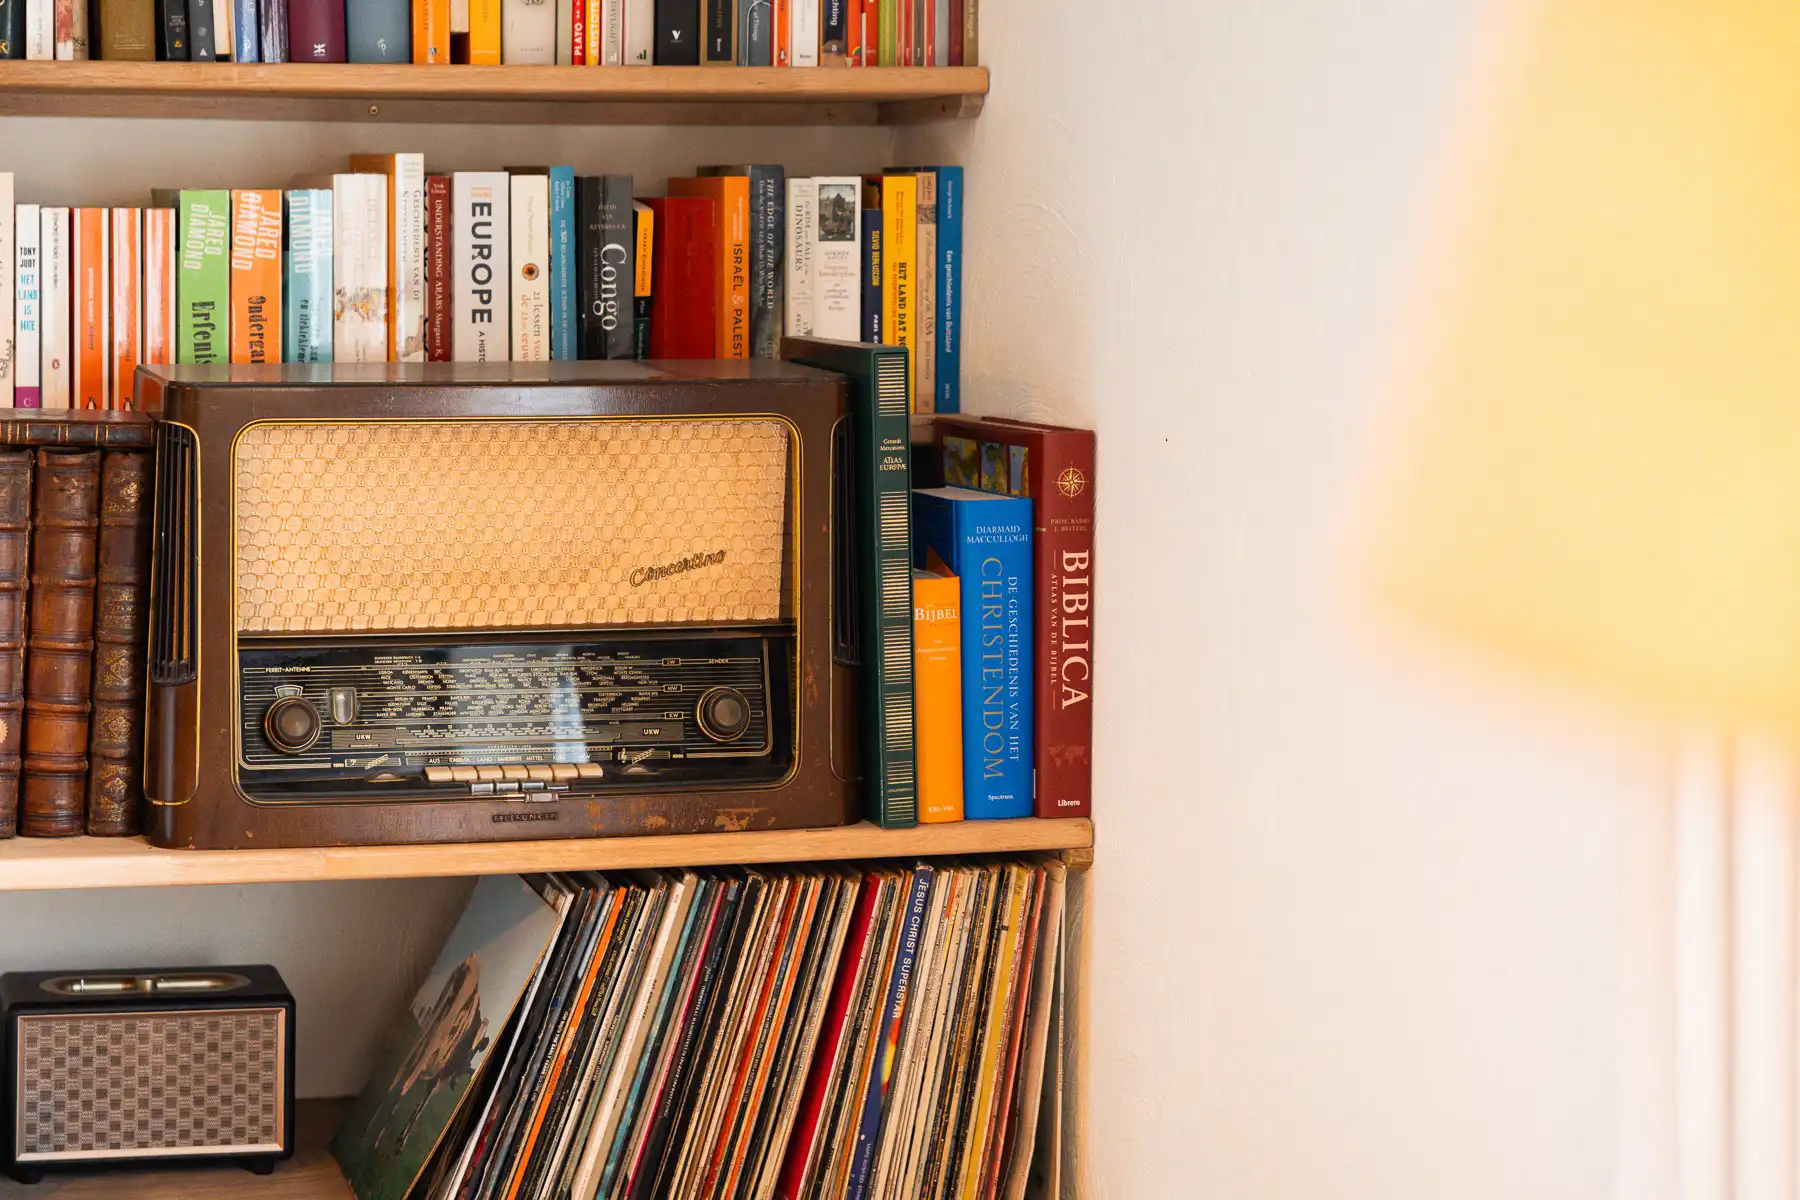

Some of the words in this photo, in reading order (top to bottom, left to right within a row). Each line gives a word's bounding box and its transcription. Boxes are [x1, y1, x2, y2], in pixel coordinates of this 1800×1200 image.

[573, 22, 583, 56] PLATO
[183, 203, 210, 271] DIAMOND
[203, 211, 228, 258] JARED
[231, 191, 263, 271] DIAMOND
[255, 207, 281, 260] JARED
[290, 196, 314, 275] DIAMOND
[434, 200, 443, 278] UNDERSTANDING
[795, 205, 803, 272] DINOSAURS
[871, 231, 880, 250] SILVIO
[20, 246, 37, 256] TONY
[20, 258, 36, 268] JUDT
[471, 202, 492, 324] EUROPE
[733, 243, 745, 292] ISRAËL
[899, 262, 908, 281] HET
[18, 290, 38, 300] LAND
[433, 280, 443, 310] ARABS
[521, 295, 531, 308] de
[592, 244, 627, 331] Congo
[898, 284, 908, 310] LAND
[24, 305, 32, 316] IS
[533, 304, 544, 337] lessen
[898, 313, 908, 336] DAT
[732, 308, 743, 358] PALEST
[883, 456, 903, 464] ATLAS
[976, 525, 1021, 534] DIARMAID
[629, 549, 727, 588] Concertino
[1007, 576, 1018, 593] DE
[1050, 573, 1058, 604] ATLAS
[913, 607, 959, 623] BIJBEL
[1050, 607, 1058, 628] VAN
[1060, 549, 1090, 710] BIBLICA
[1007, 599, 1019, 698] GESCHIEDENIS
[1050, 631, 1058, 647] DE
[981, 557, 1005, 781] CHRISTENDOM
[1049, 649, 1058, 685] BIJBEL
[1008, 702, 1019, 730] VAN
[355, 733, 374, 741] UKW
[643, 728, 660, 736] UKW
[1008, 736, 1019, 762] HET
[988, 792, 1015, 801] Spectrum
[1057, 799, 1082, 807] Librero
[912, 878, 928, 915] JESUS
[904, 915, 921, 956] CHRIST
[891, 956, 914, 1020] SUPERSTAR
